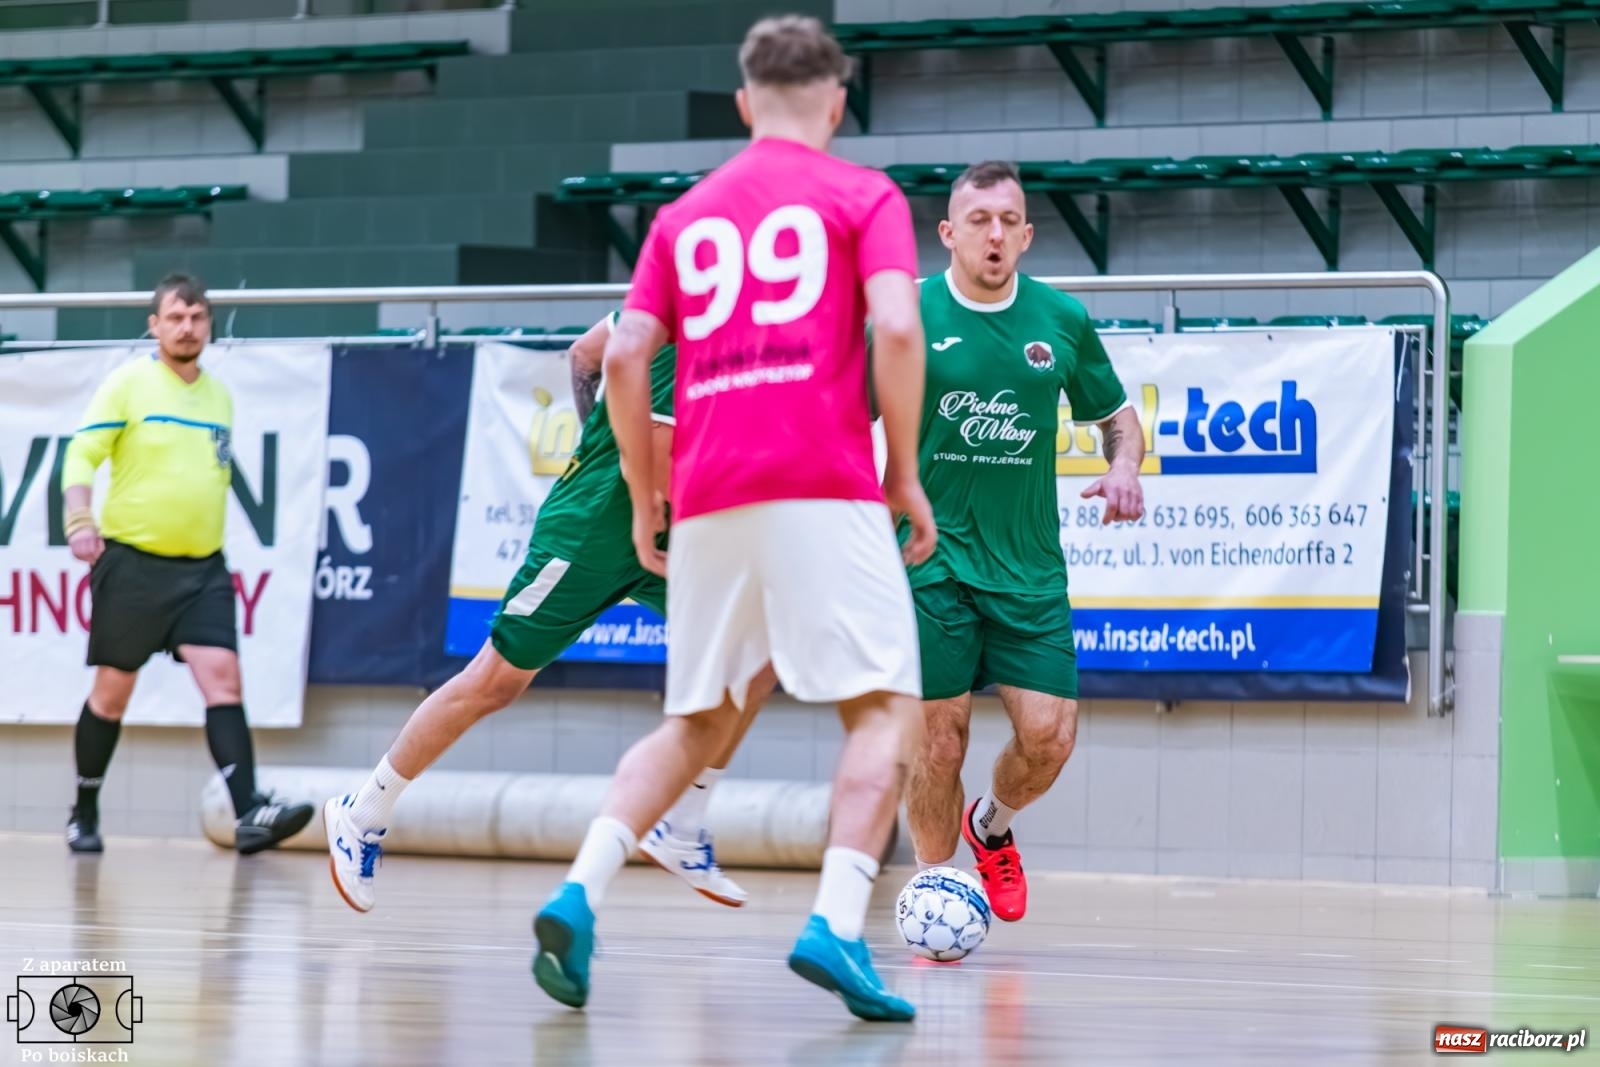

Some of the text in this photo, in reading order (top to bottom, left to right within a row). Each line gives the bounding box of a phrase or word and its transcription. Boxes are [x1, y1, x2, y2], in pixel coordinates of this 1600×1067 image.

[674, 203, 829, 342] 99
[937, 389, 1020, 421] Piękne
[959, 412, 1037, 456] Włosy
[932, 452, 968, 463] STUDIO
[972, 454, 1033, 466] FRYZJERSKIE
[1153, 505, 1188, 528] 632
[1194, 505, 1236, 531] 695,
[1246, 504, 1283, 527] 606
[1289, 503, 1322, 527] 363
[1328, 503, 1369, 526] 647
[1123, 541, 1147, 567] ul.
[1170, 547, 1205, 567] von
[1211, 540, 1336, 567] Eichendorffa
[1343, 542, 1354, 565] 2
